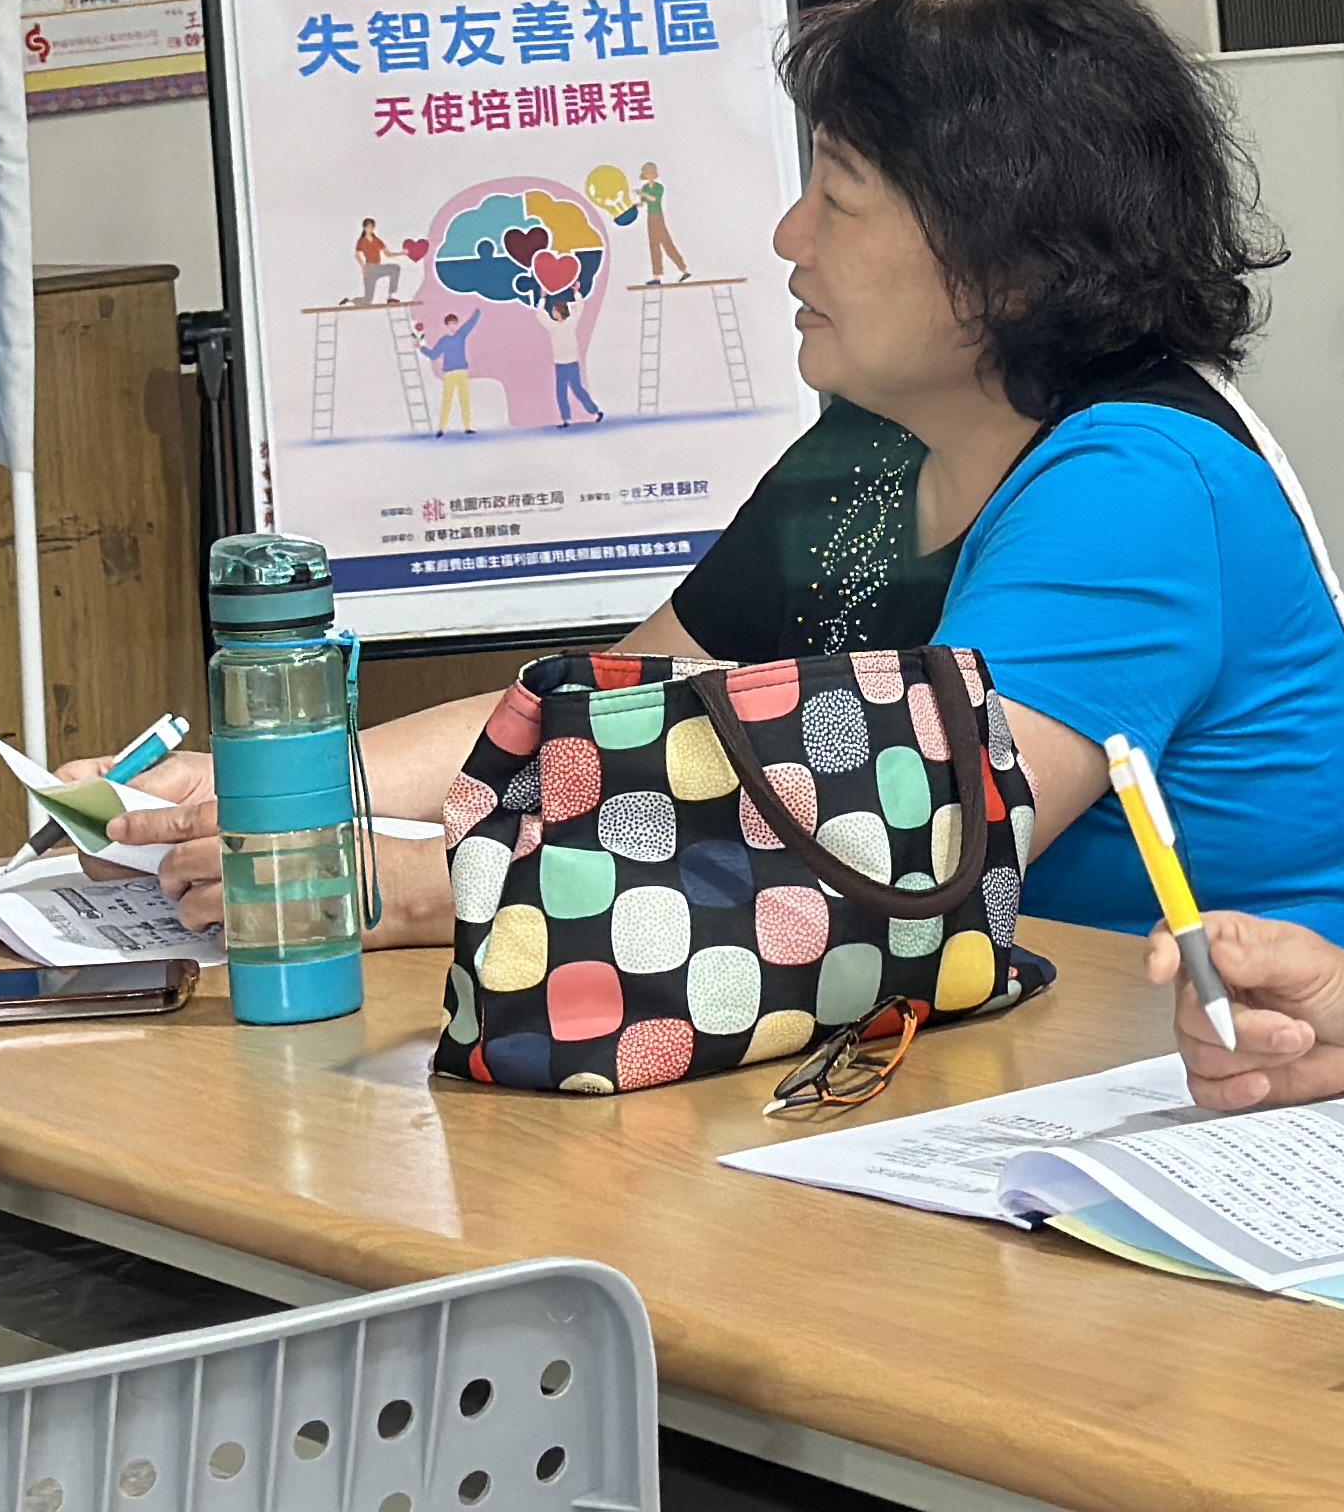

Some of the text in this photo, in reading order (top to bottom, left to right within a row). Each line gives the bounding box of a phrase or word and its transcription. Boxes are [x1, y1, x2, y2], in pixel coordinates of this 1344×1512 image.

[374, 80, 656, 138] 天使培訓課程
[449, 490, 565, 513] 桃園市政府衛生局
